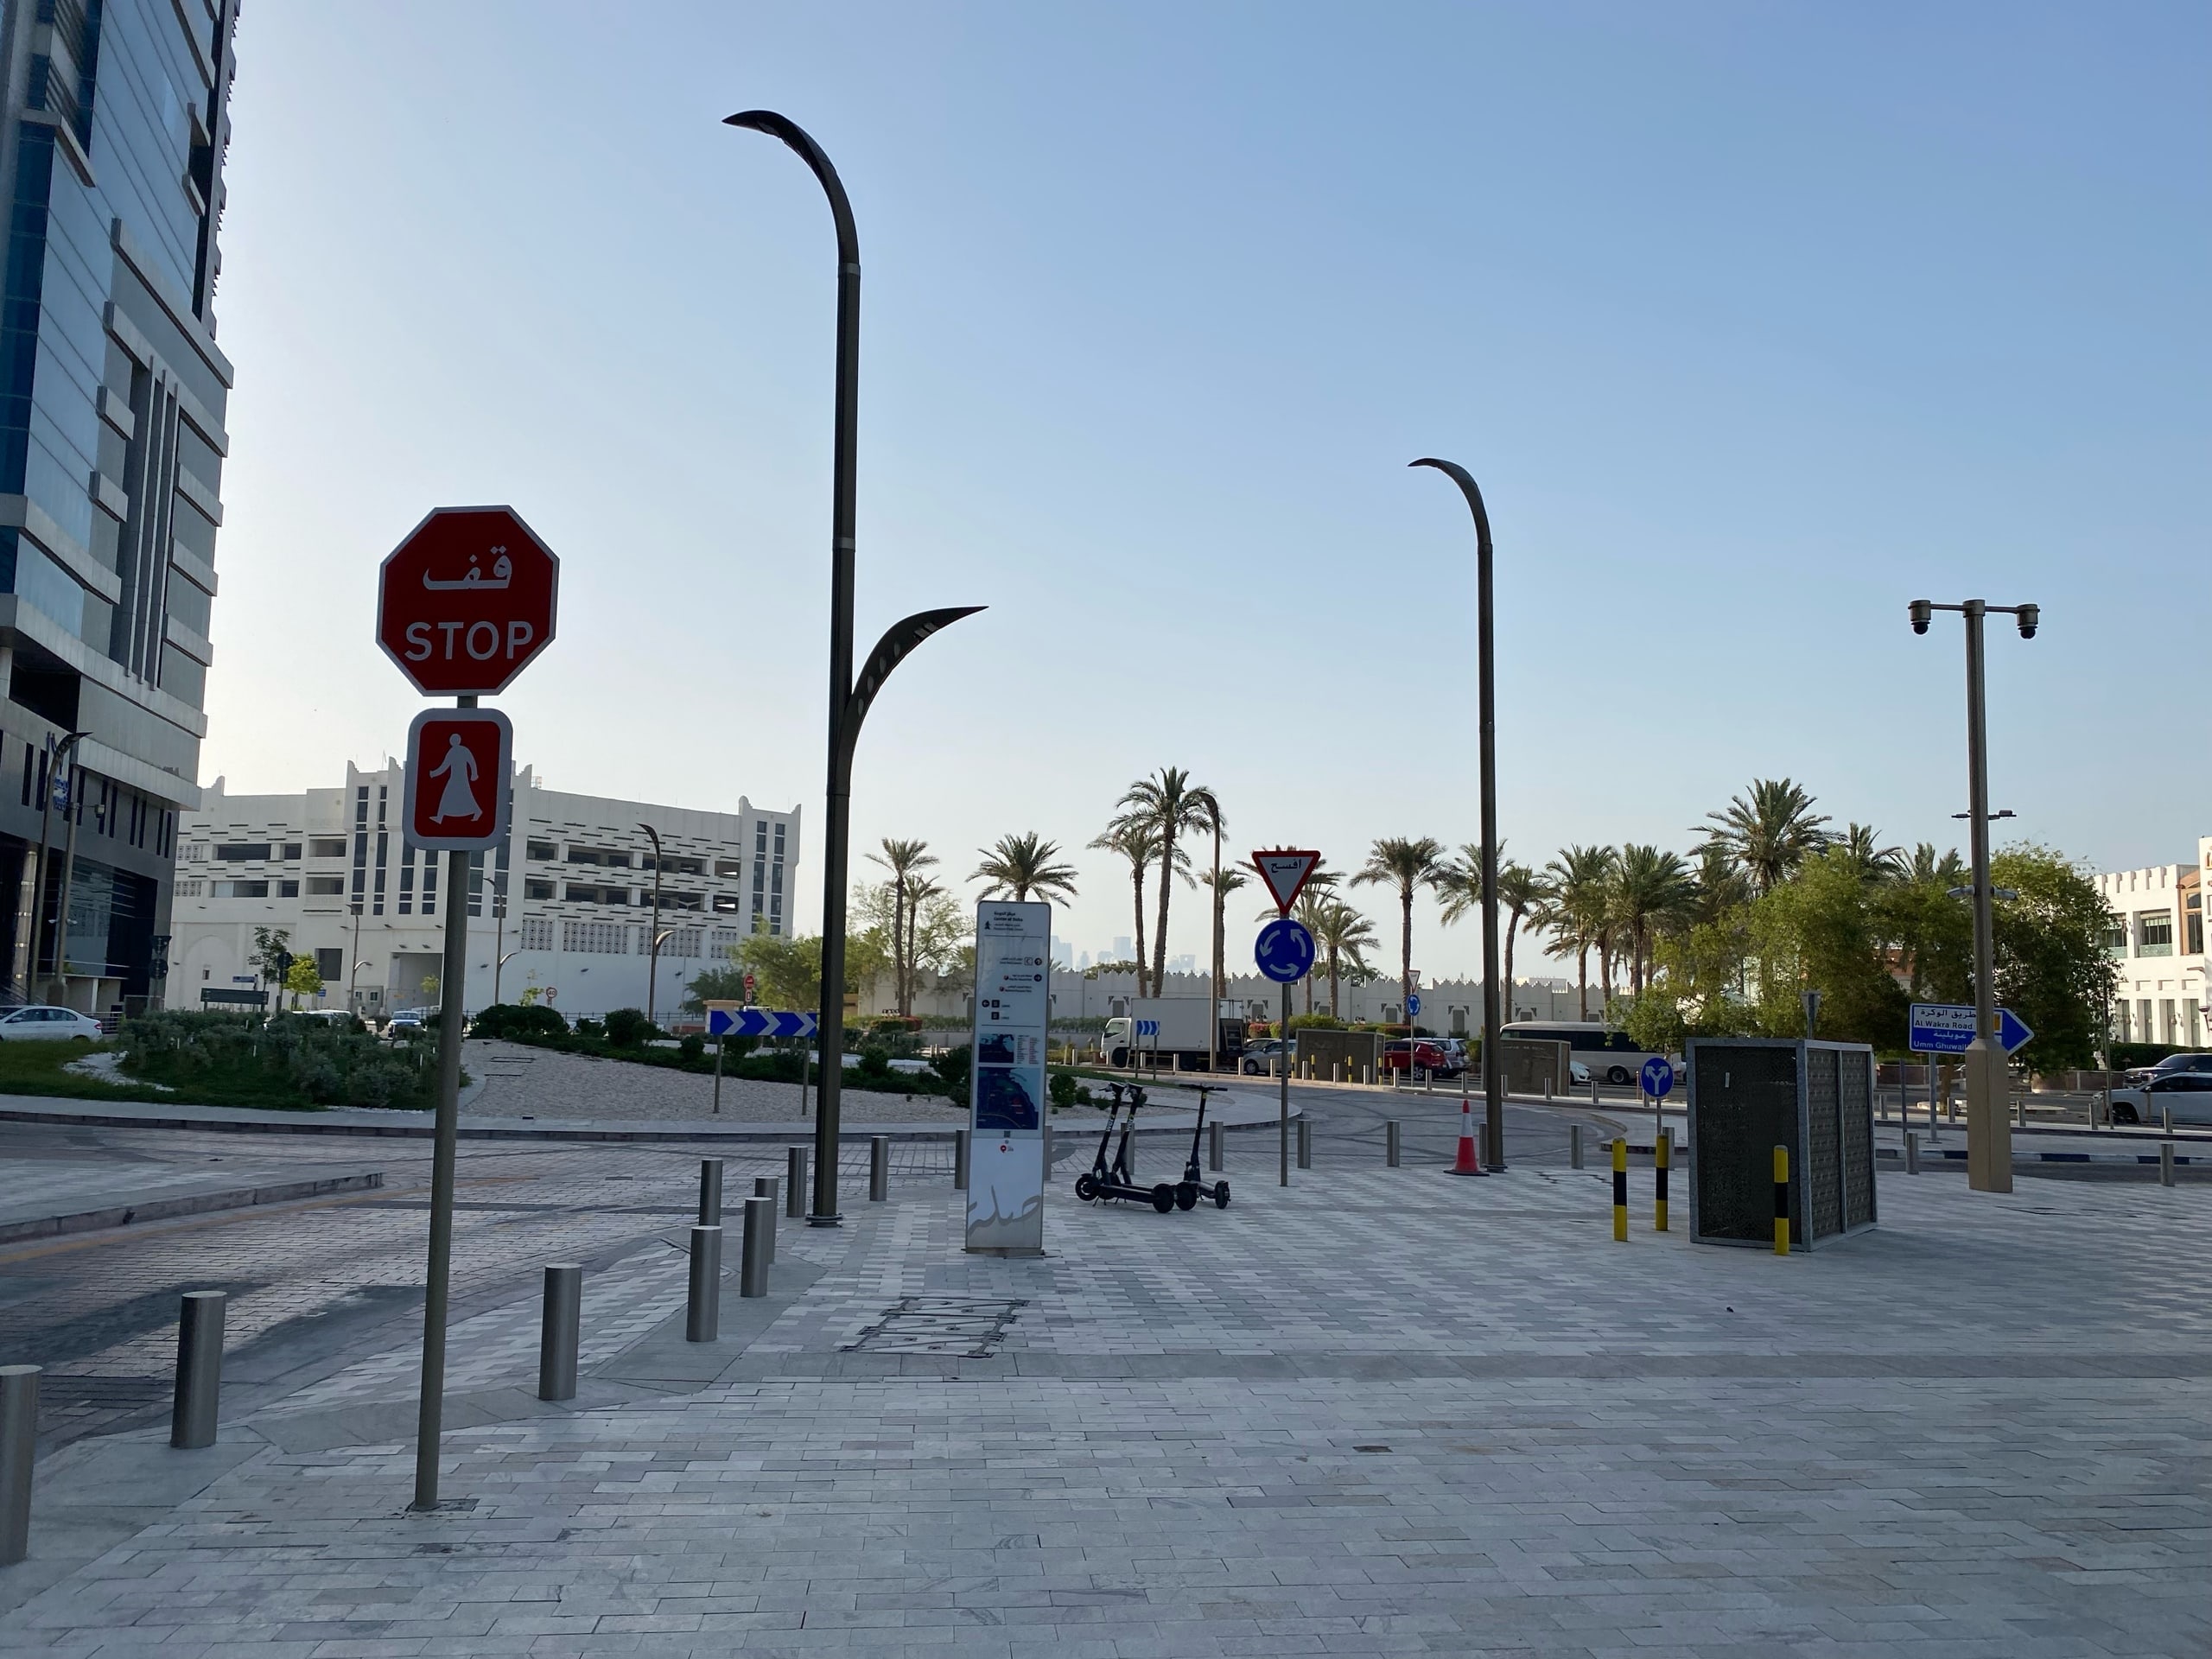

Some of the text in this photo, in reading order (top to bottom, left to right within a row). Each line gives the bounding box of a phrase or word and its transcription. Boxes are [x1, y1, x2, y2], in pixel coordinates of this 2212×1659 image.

[423, 545, 512, 590] قف
[404, 620, 534, 661] STOP
[1270, 858, 1302, 874] افسح
[1921, 1008, 1976, 1020] طريق الوكرة
[1936, 1041, 1967, 1051] Ghuwail
